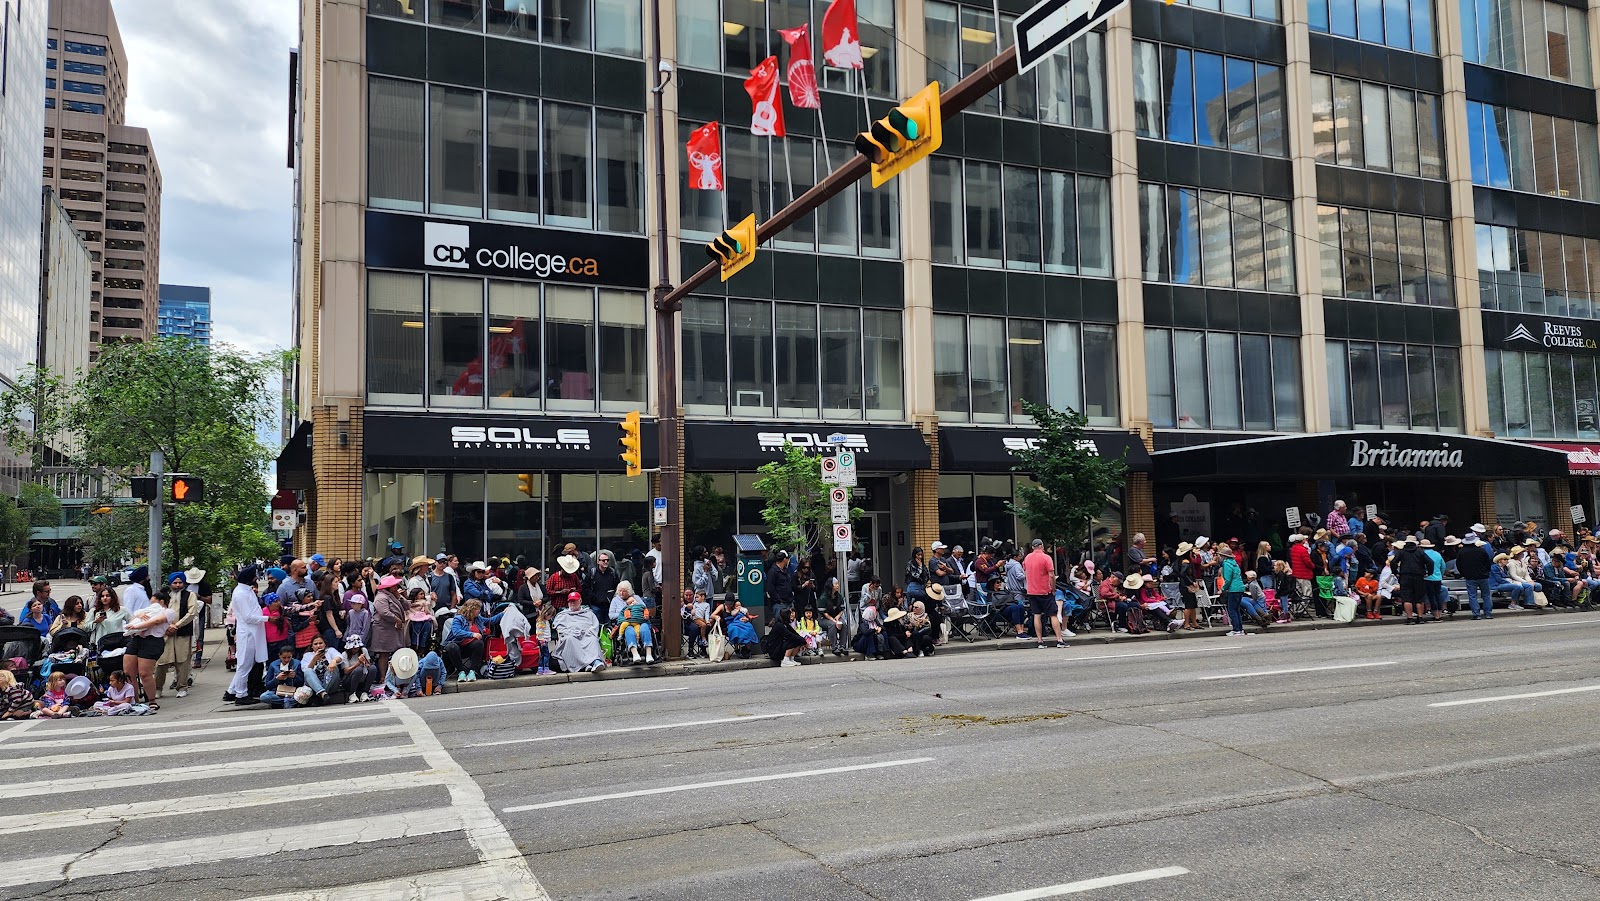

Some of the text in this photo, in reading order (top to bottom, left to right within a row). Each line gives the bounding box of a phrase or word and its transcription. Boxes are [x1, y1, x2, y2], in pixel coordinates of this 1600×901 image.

[475, 245, 599, 278] college.ca
[1543, 321, 1582, 337] REEVES
[1543, 334, 1597, 349] COLLEGE.CA
[451, 426, 590, 444] SOLE
[1350, 439, 1464, 468] Britannia
